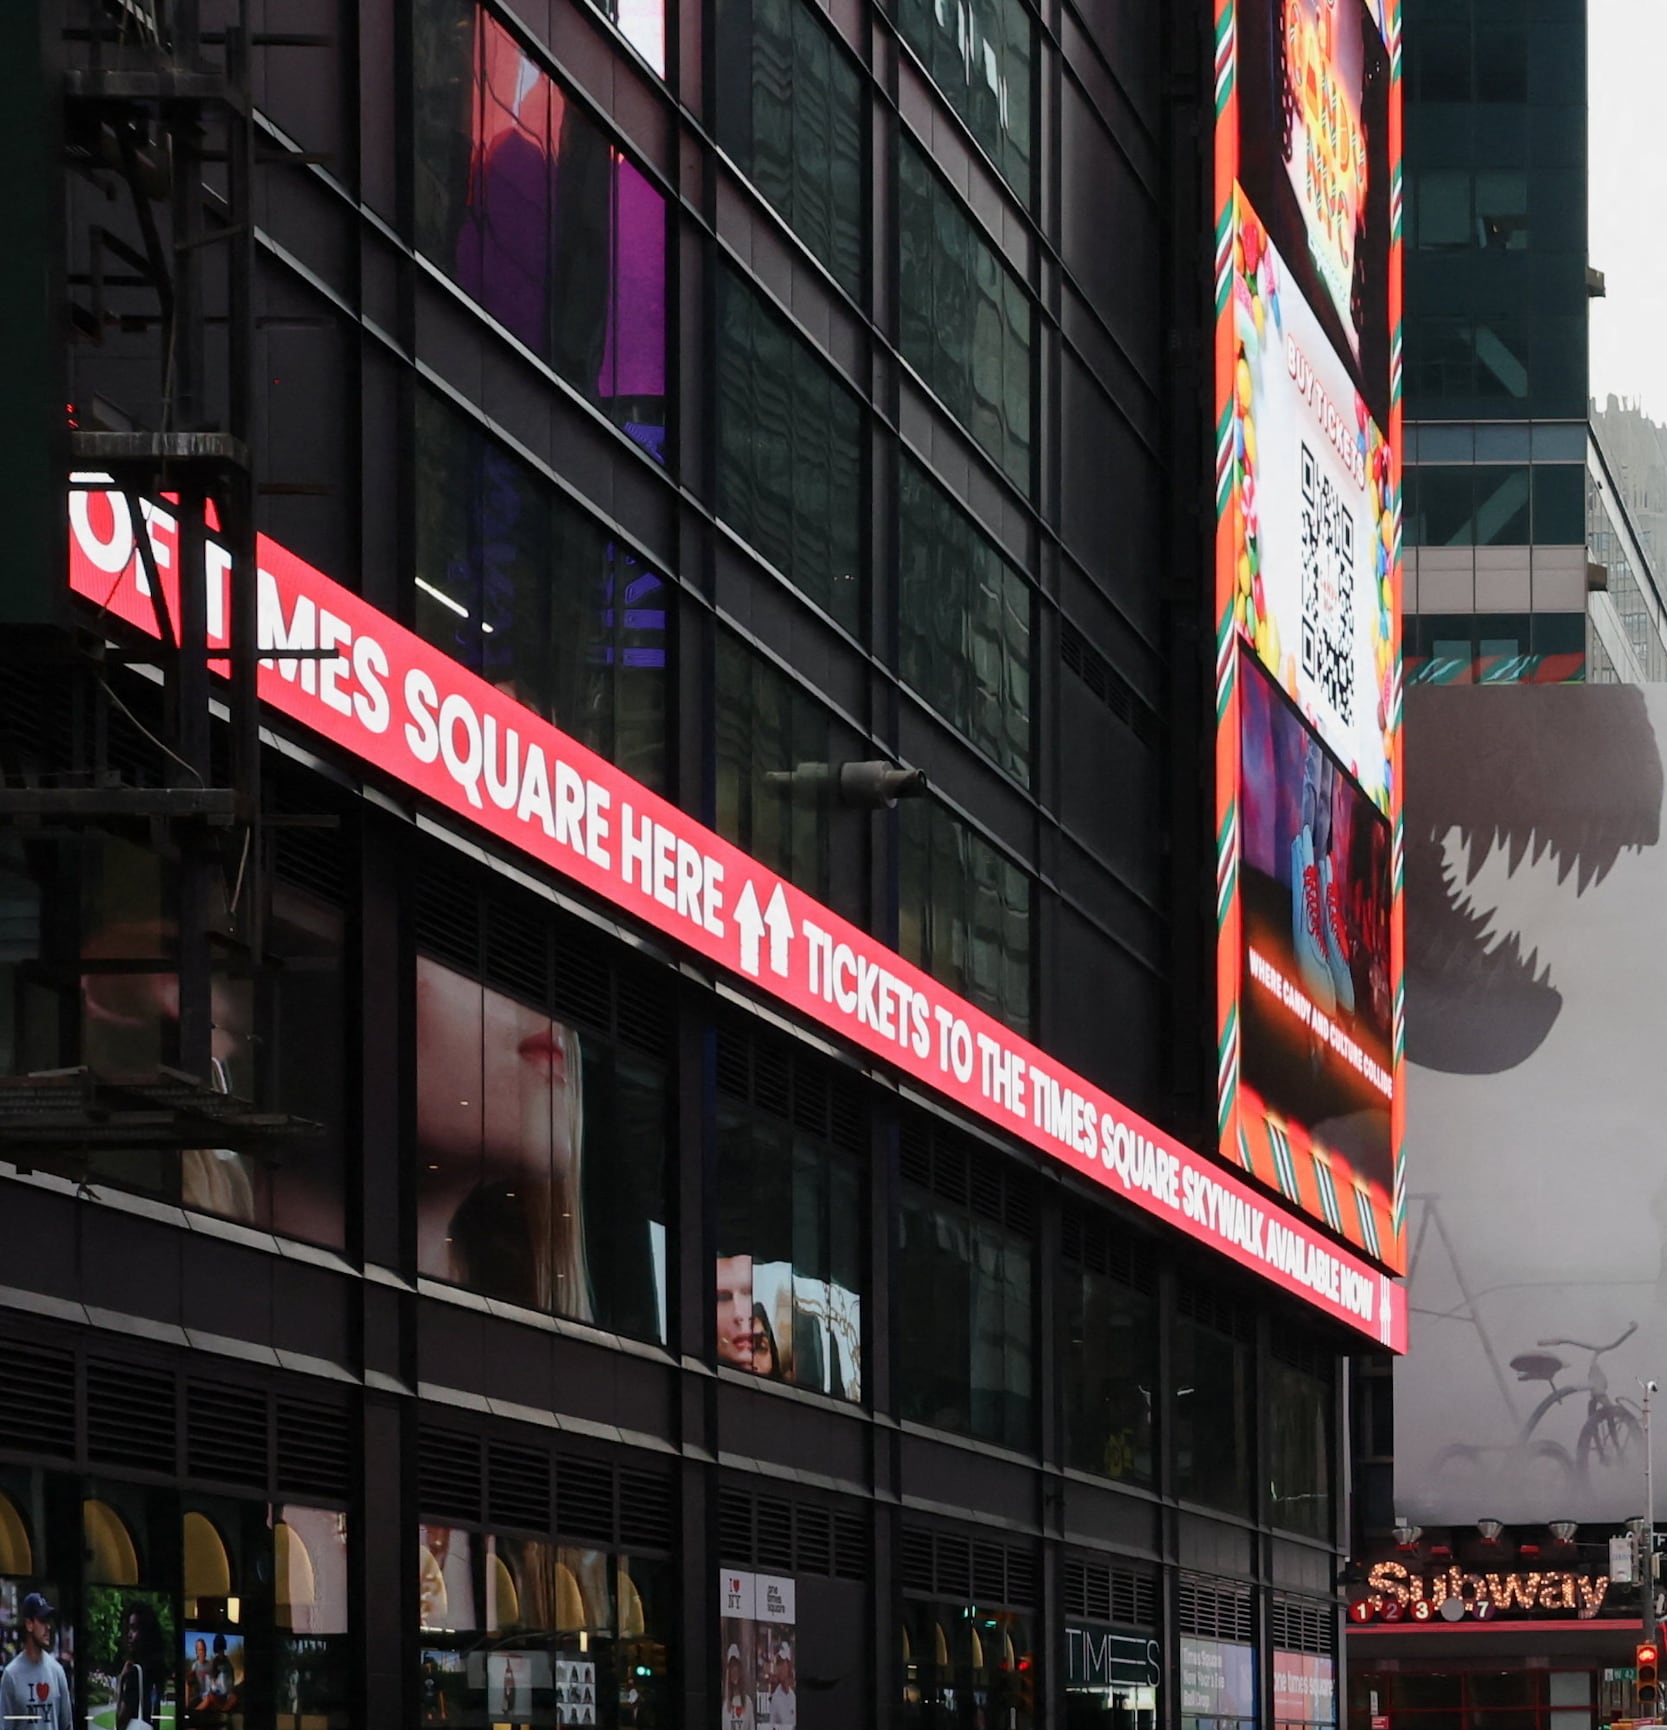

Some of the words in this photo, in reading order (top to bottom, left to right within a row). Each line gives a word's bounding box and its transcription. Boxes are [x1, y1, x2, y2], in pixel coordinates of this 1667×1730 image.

[1287, 333, 1314, 407] BUY
[1314, 378, 1366, 491] TICKETS
[206, 539, 389, 733] TMES
[404, 668, 611, 871] SQUARE
[622, 802, 724, 938] HERE
[803, 919, 931, 1059] TICKETS
[934, 1004, 973, 1083] TO
[977, 1032, 1025, 1118] THE
[1030, 1065, 1097, 1160] TIMES
[1101, 1113, 1180, 1210] SQUARE
[1182, 1165, 1265, 1259] SKYWALK
[1266, 1218, 1340, 1304] AVAILABLE
[1340, 1266, 1374, 1322] NOW
[1249, 945, 1282, 1000] WHERE
[1282, 978, 1312, 1025] CANDY
[1311, 1007, 1329, 1042] AND
[1329, 1023, 1363, 1073] CULTURE
[1363, 1053, 1393, 1100] COLLIDE
[1356, 1603, 1367, 1619] 1
[1386, 1604, 1399, 1619] 2
[1416, 1602, 1428, 1619] 3
[1477, 1601, 1488, 1618] 7
[1368, 1560, 1609, 1619] Subway
[1065, 1628, 1161, 1688] TIMES
[27, 1704, 52, 1724] NY
[28, 1683, 35, 1702] I
[1287, 1672, 1309, 1693] times
[1309, 1674, 1334, 1705] square
